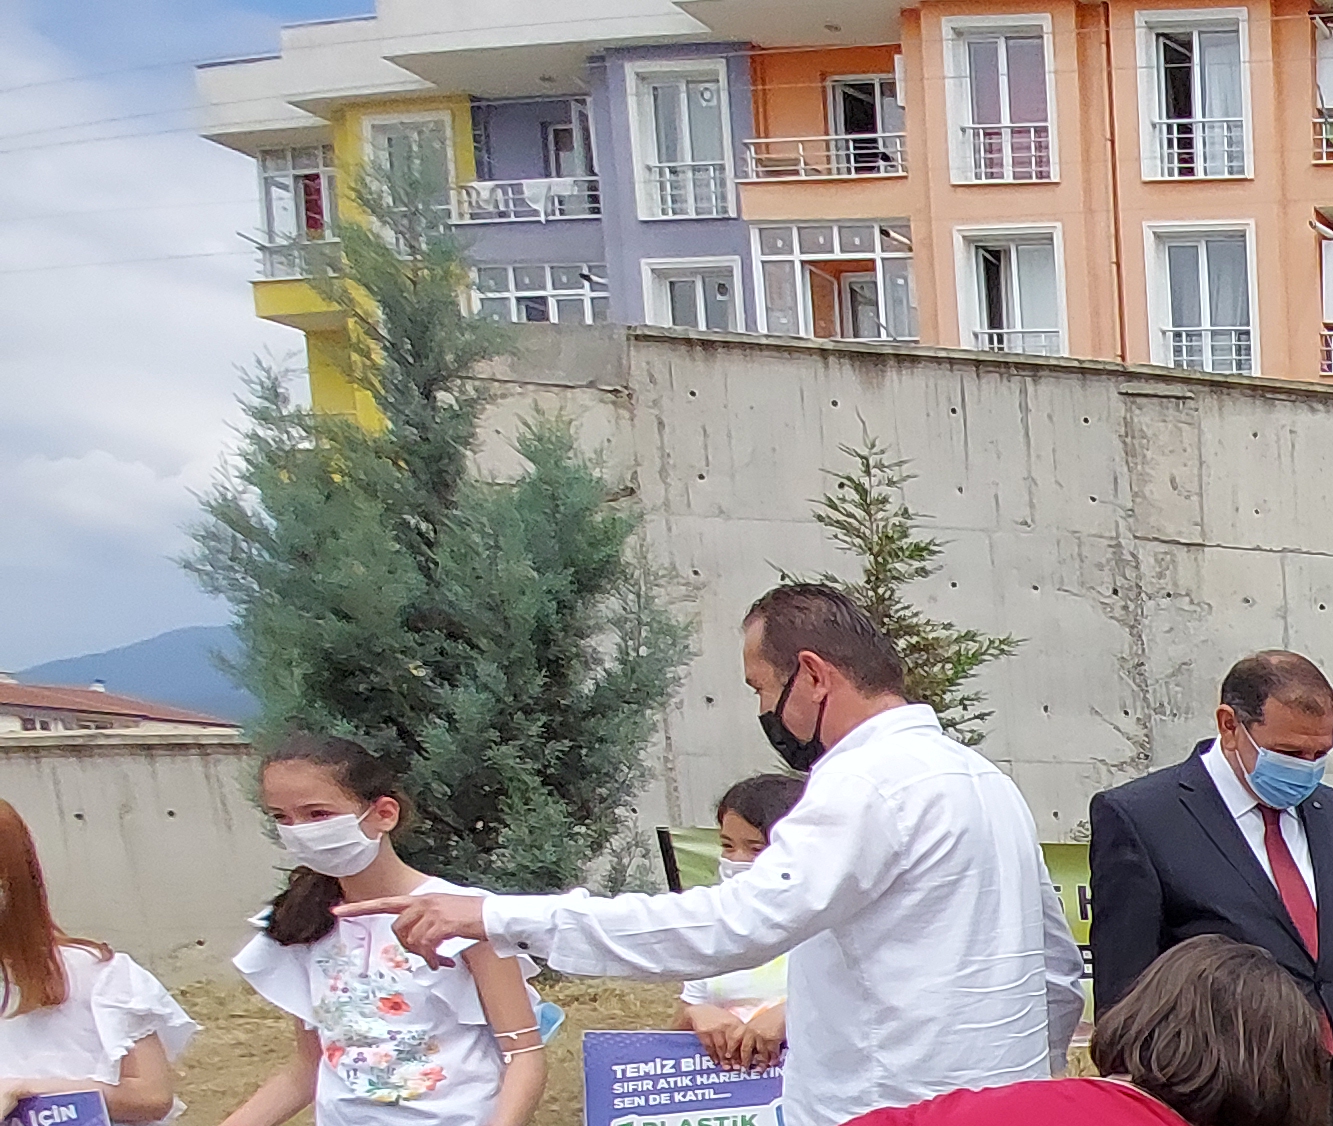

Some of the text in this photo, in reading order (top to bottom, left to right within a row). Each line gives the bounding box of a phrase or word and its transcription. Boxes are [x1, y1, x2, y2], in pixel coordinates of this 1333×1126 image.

[611, 1054, 716, 1078] TEMİZ BİR
[612, 1080, 653, 1093] SIFIR
[657, 1075, 693, 1090] ATIK
[613, 1095, 646, 1109] SEN
[648, 1092, 671, 1105] DE
